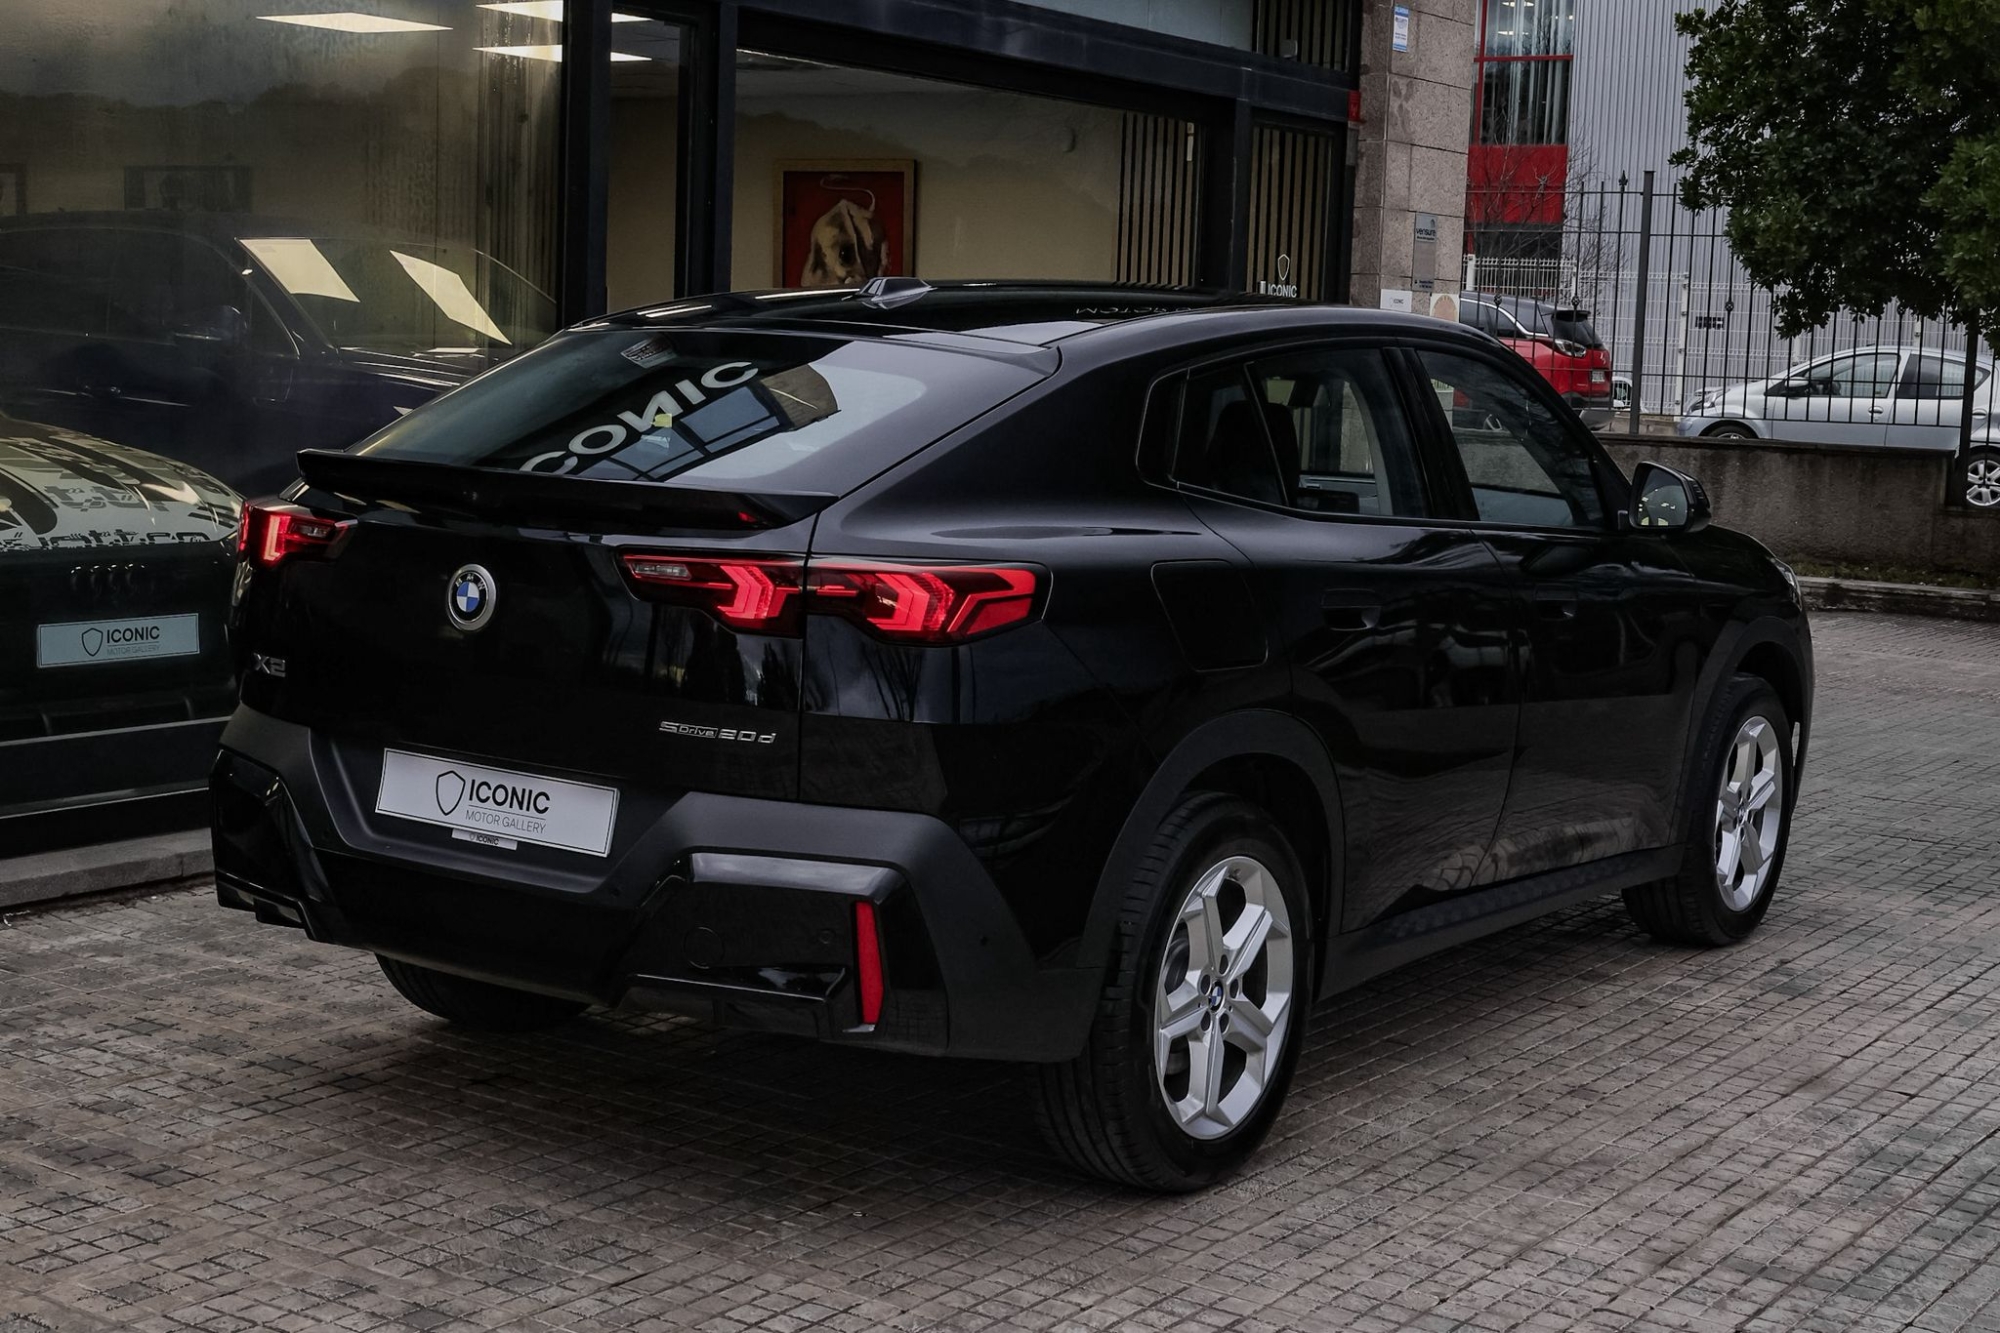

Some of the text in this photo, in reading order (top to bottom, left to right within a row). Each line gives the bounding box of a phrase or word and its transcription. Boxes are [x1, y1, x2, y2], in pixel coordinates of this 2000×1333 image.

[1267, 283, 1297, 298] ICONIC
[106, 626, 160, 644] ICONIC
[253, 652, 286, 677] X2
[468, 778, 551, 814] ICONIC
[465, 810, 547, 834] MOTOR GALLERY
[475, 834, 500, 846] ICONIC
